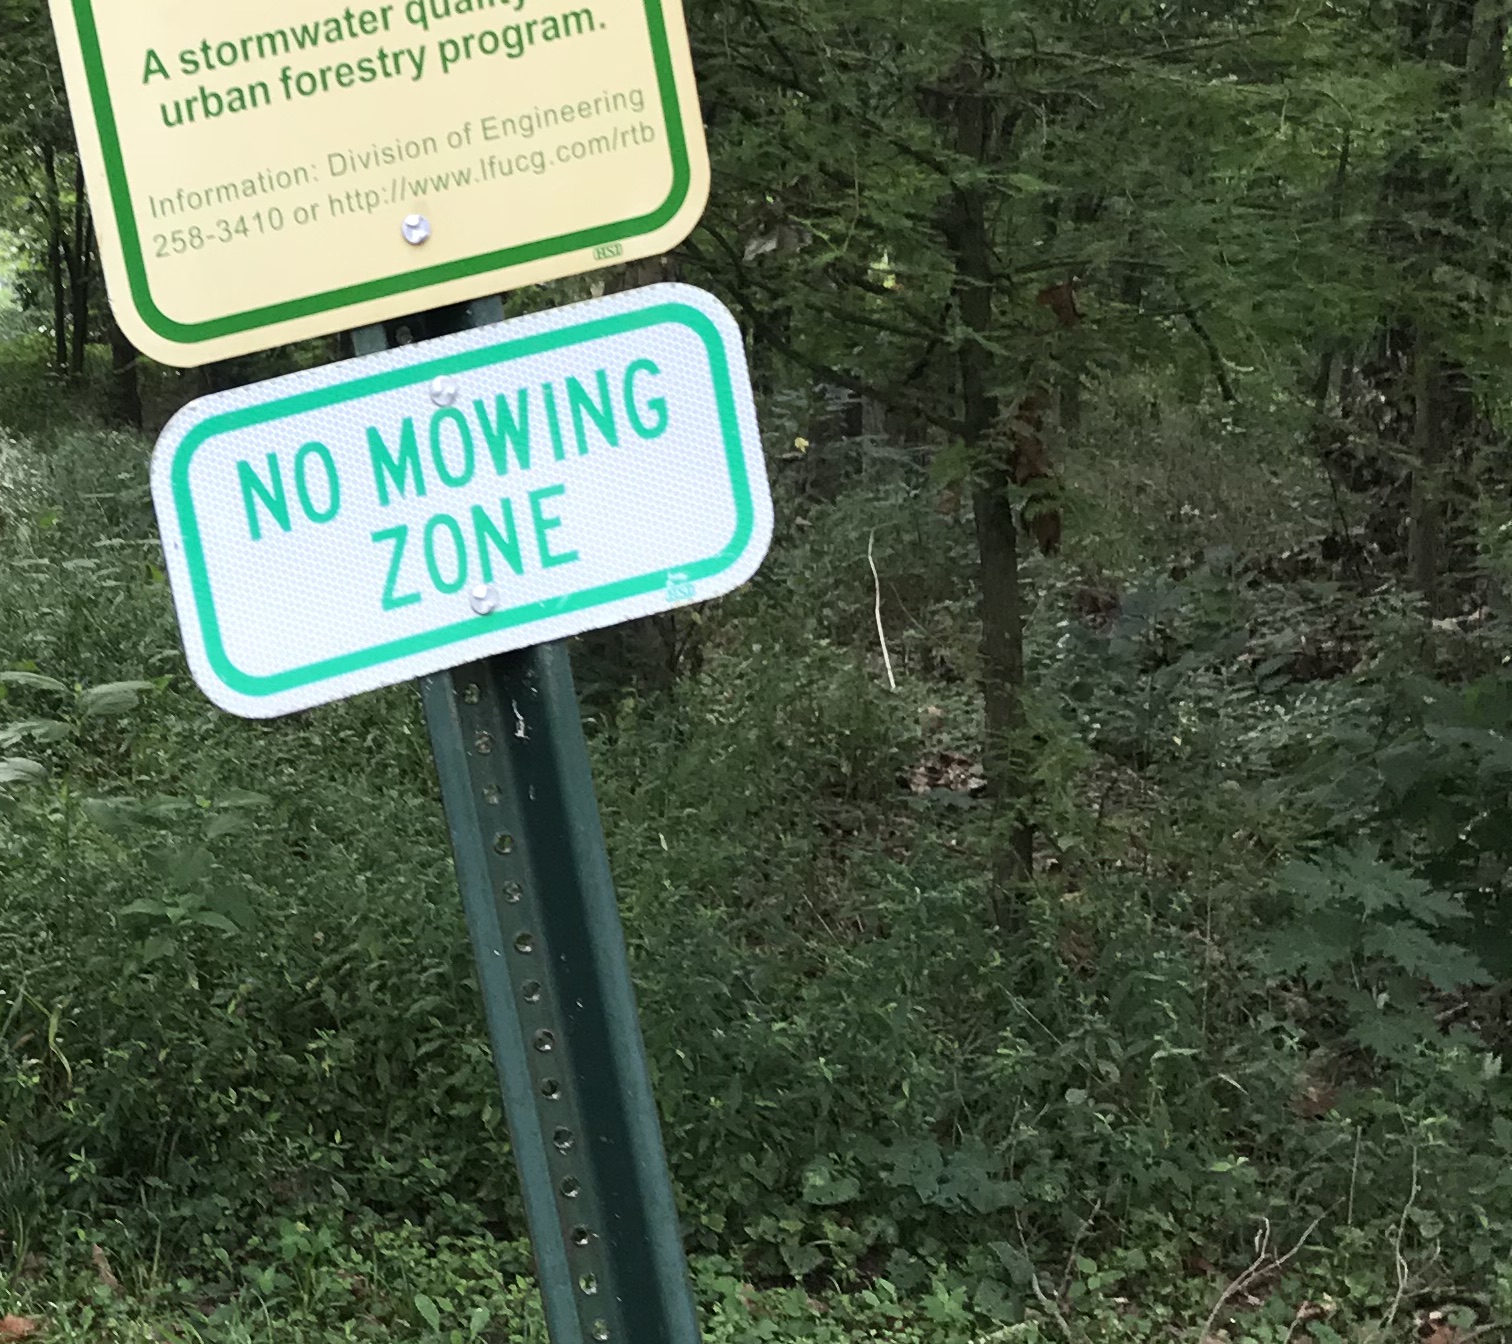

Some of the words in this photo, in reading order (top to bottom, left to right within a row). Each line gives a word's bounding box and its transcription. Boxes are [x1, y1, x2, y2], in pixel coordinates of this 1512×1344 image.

[142, 47, 171, 84] A
[178, 6, 393, 75] stormwater
[160, 85, 271, 128] urban
[278, 45, 426, 101] forestry
[437, 7, 606, 74] program.
[149, 163, 320, 219] Information:
[326, 135, 438, 177] Division
[447, 122, 472, 150] of
[481, 88, 645, 142] Engineering
[152, 206, 284, 259] 258-3410
[293, 203, 320, 226] or
[328, 121, 656, 218] http://www.lfucg.com/rtb
[235, 440, 341, 540] NO
[365, 358, 670, 508] MOWING
[370, 483, 580, 612] ZONE
